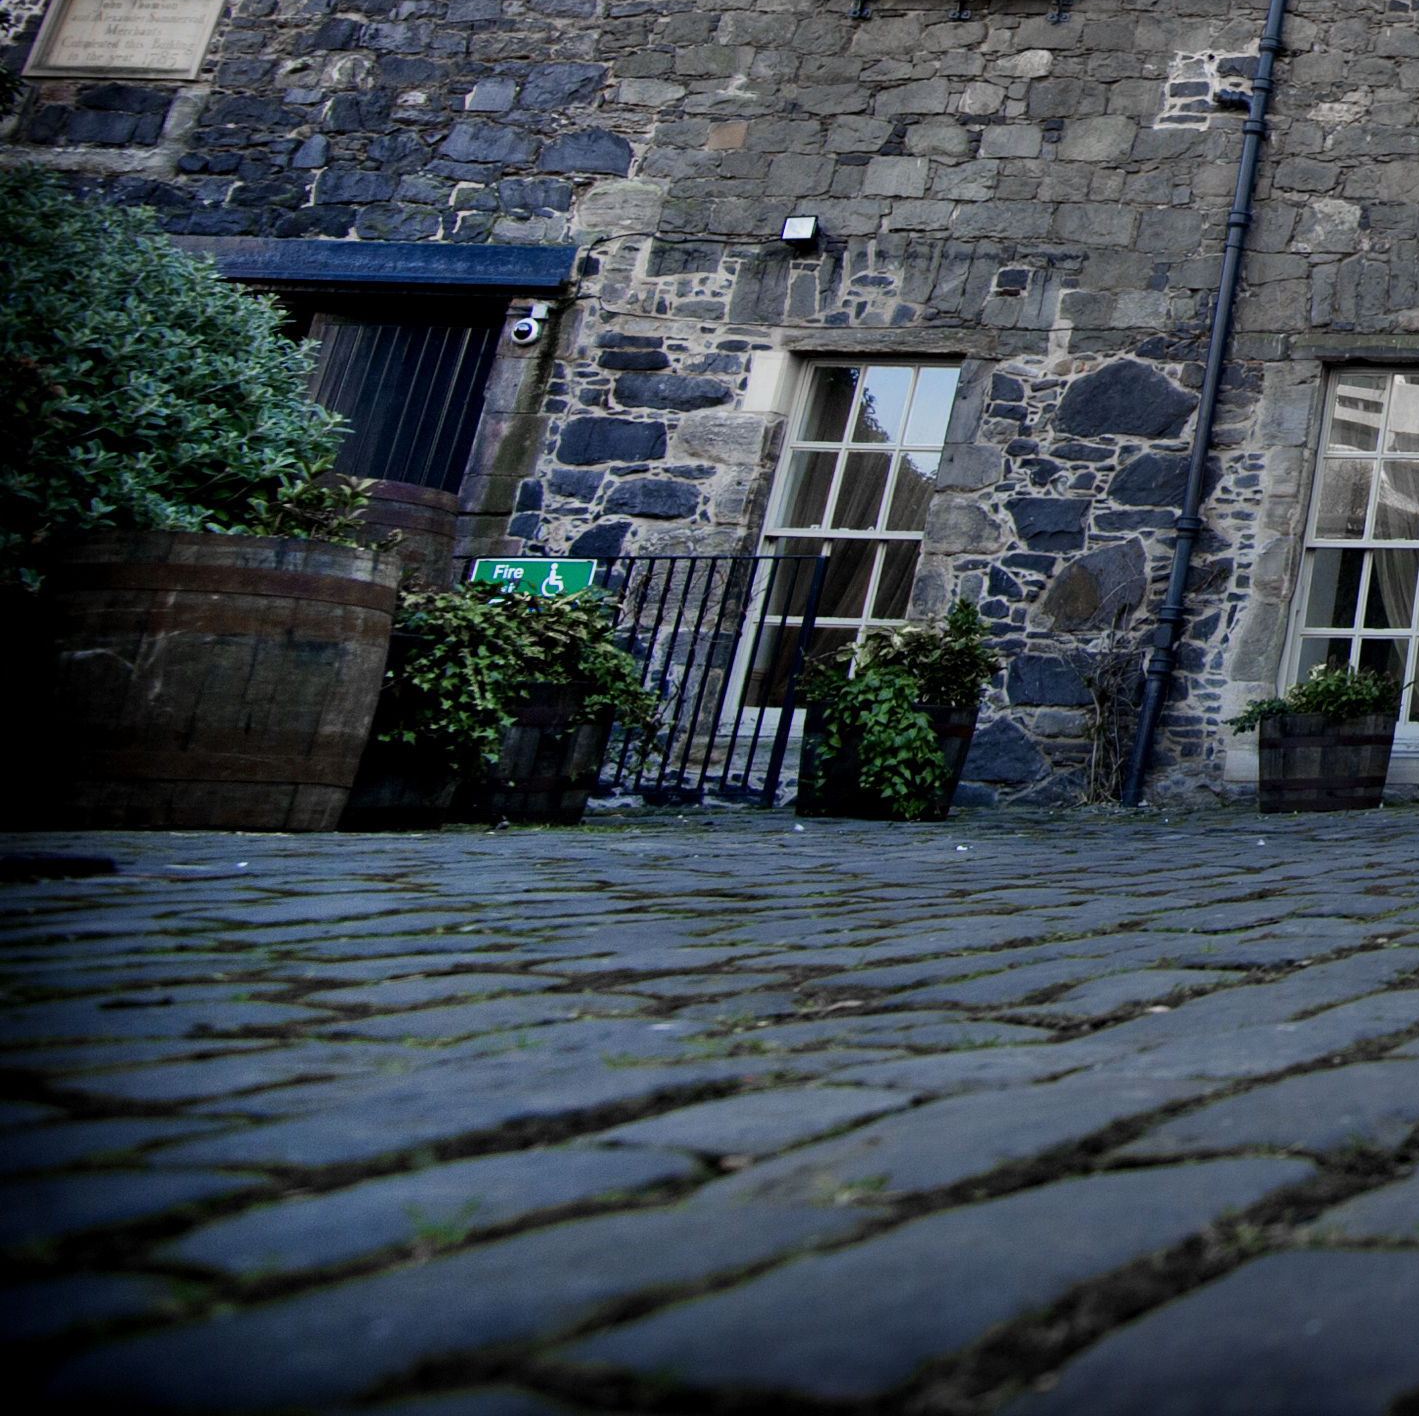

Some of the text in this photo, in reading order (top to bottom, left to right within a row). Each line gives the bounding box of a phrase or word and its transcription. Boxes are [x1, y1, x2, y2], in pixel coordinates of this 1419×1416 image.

[70, 12, 90, 22] and
[92, 10, 145, 22] Alexander
[103, 23, 162, 36] Merchants
[125, 39, 143, 49] this
[86, 51, 104, 61] the
[107, 53, 135, 65] year
[141, 49, 180, 68] 1785
[493, 564, 525, 579] Fire
